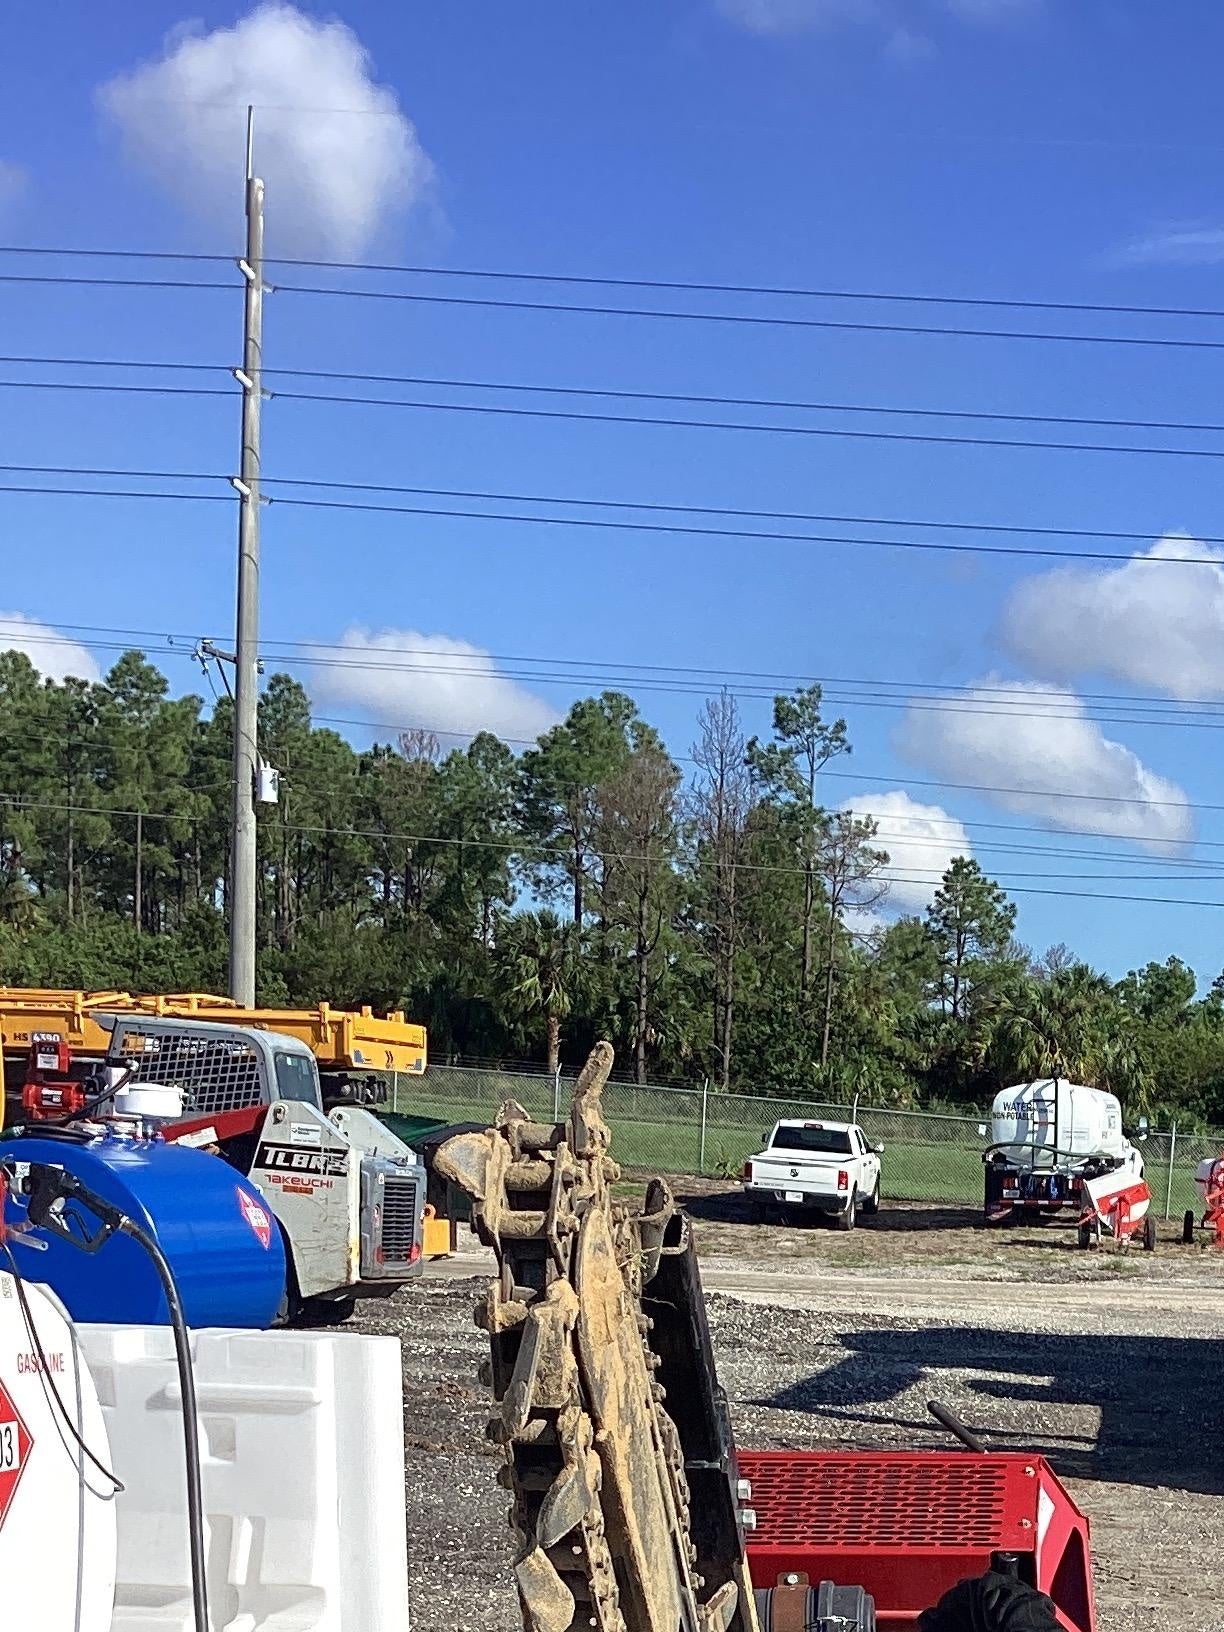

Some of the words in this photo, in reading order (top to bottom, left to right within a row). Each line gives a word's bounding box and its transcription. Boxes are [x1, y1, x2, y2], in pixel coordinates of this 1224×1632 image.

[1003, 1101, 1034, 1112] WATER
[16, 1352, 65, 1374] GASINE
[0, 1425, 14, 1467] 3
